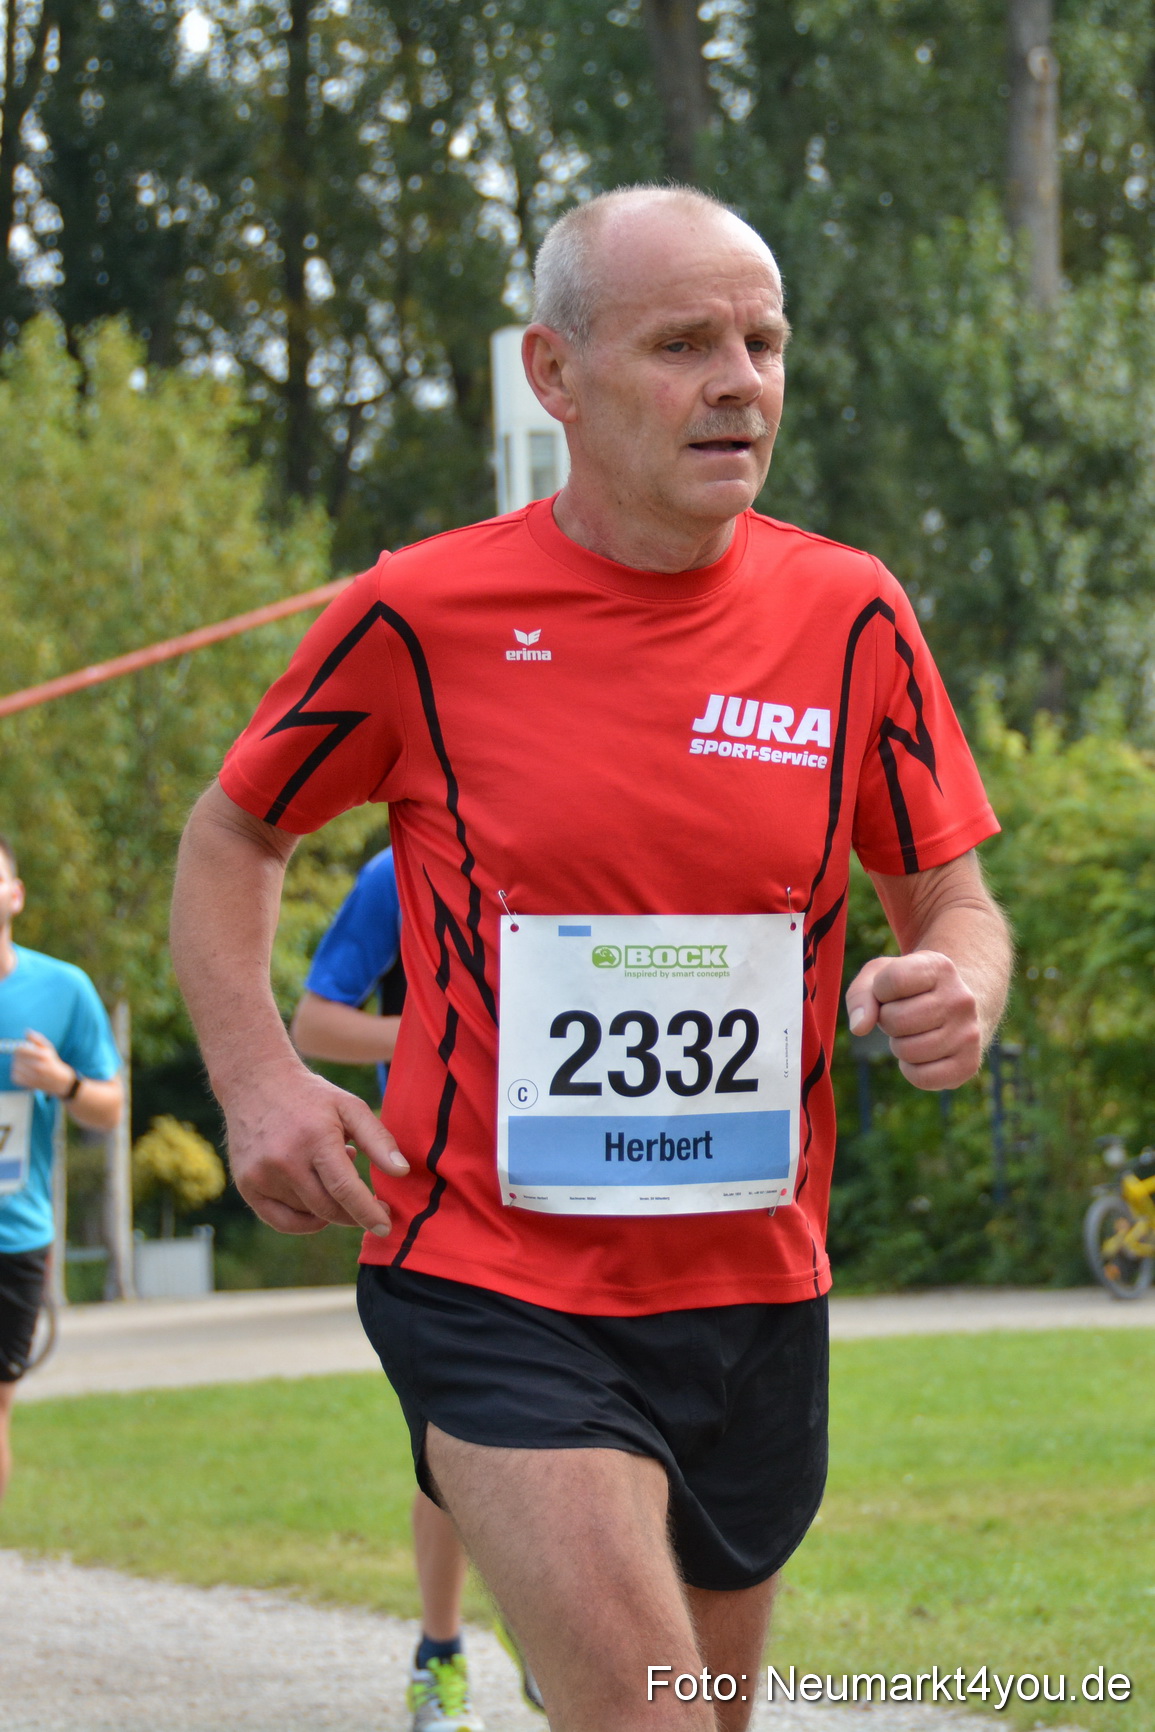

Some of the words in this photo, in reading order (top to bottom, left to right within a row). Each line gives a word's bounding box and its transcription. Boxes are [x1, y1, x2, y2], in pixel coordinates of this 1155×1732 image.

[506, 648, 552, 661] erima
[692, 694, 831, 748] JURA
[689, 738, 828, 769] SPORT-Service
[625, 945, 729, 968] BOCK
[624, 970, 658, 978] inspired
[660, 970, 670, 978] by
[697, 970, 730, 978] concepts
[549, 1009, 760, 1098] 2332
[517, 1086, 528, 1102] C
[605, 1131, 713, 1162] Herbert
